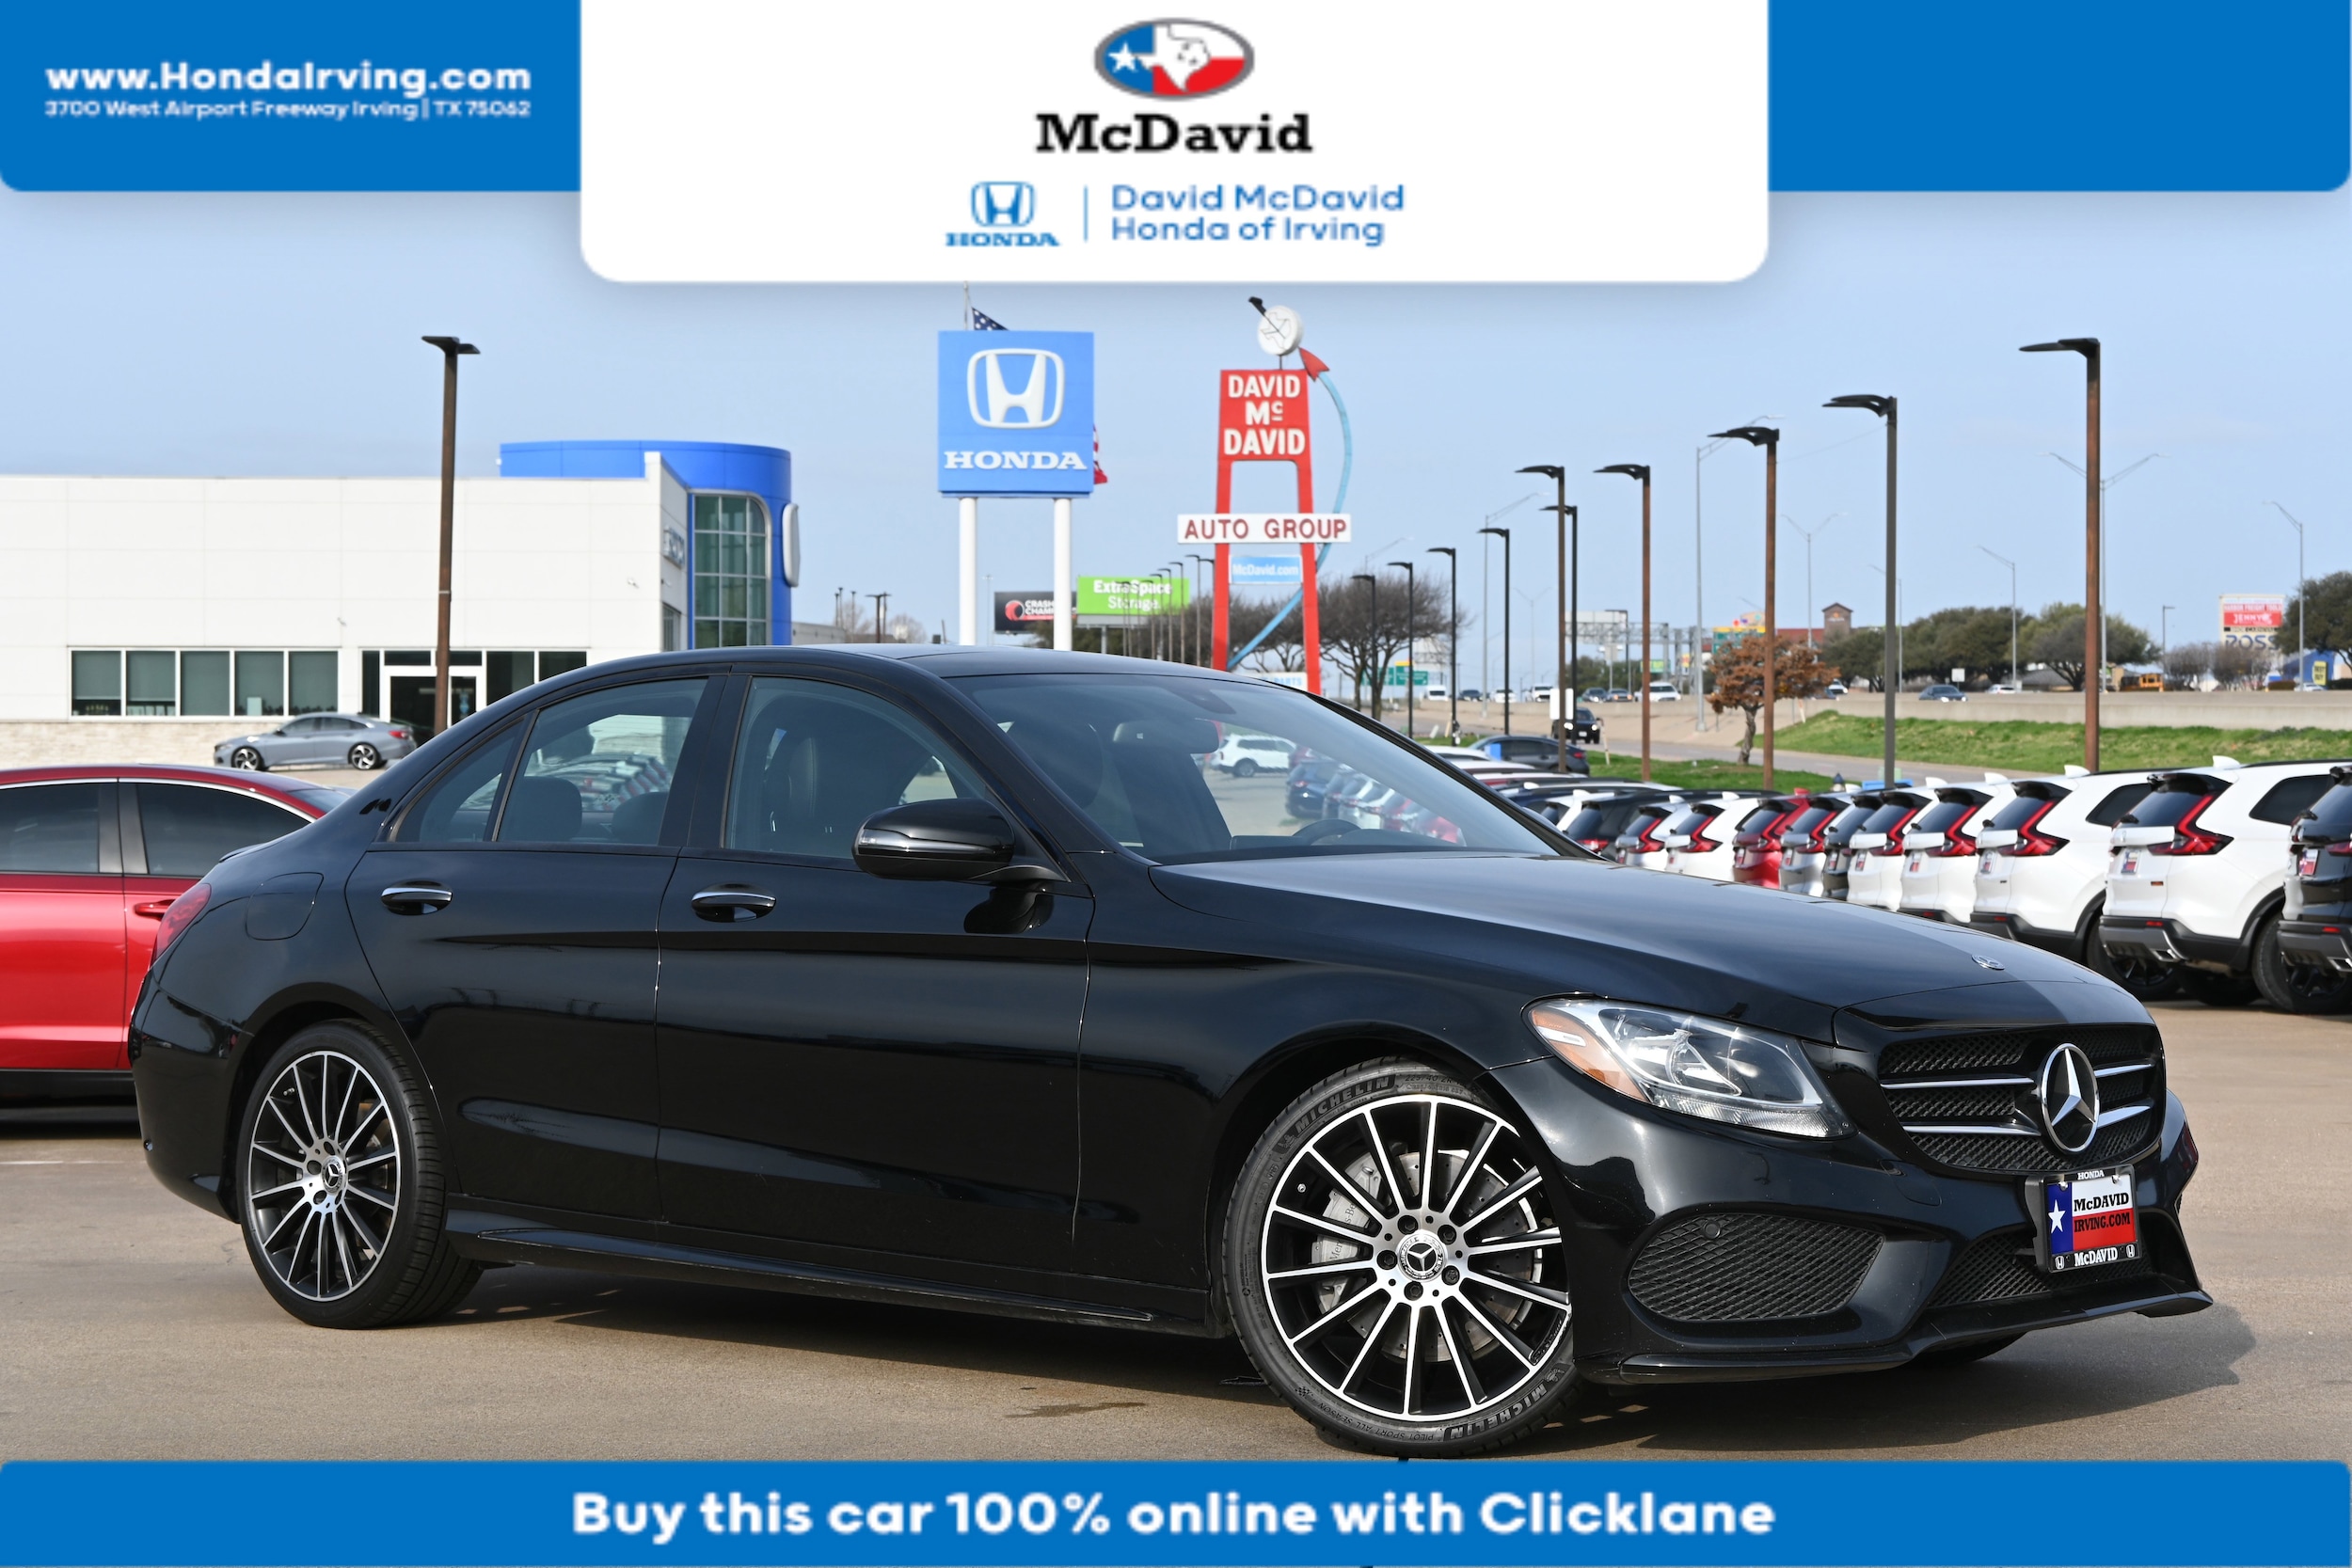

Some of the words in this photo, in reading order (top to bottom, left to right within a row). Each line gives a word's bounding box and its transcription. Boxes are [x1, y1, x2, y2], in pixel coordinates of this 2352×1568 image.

[1229, 373, 1301, 399] DAVID
[1224, 428, 1306, 456] DAVID
[944, 451, 1088, 470] HONDA
[1184, 518, 1249, 540] AUTO
[1264, 517, 1347, 540] GROUP
[1232, 562, 1299, 577] McDavid.com
[1295, 1075, 1391, 1133] MICHELIN
[2077, 1169, 2106, 1180] HONDA
[2074, 1192, 2130, 1212] McDAVID
[2074, 1212, 2131, 1233] IRVING.COM
[2074, 1246, 2119, 1267] McDAVID
[1316, 1402, 1354, 1428] SEASON
[1449, 1382, 1549, 1440] MICHELIN
[1355, 1421, 1374, 1433] ALL
[1375, 1427, 1406, 1441] SPORT
[1409, 1431, 1435, 1441] PILOT
